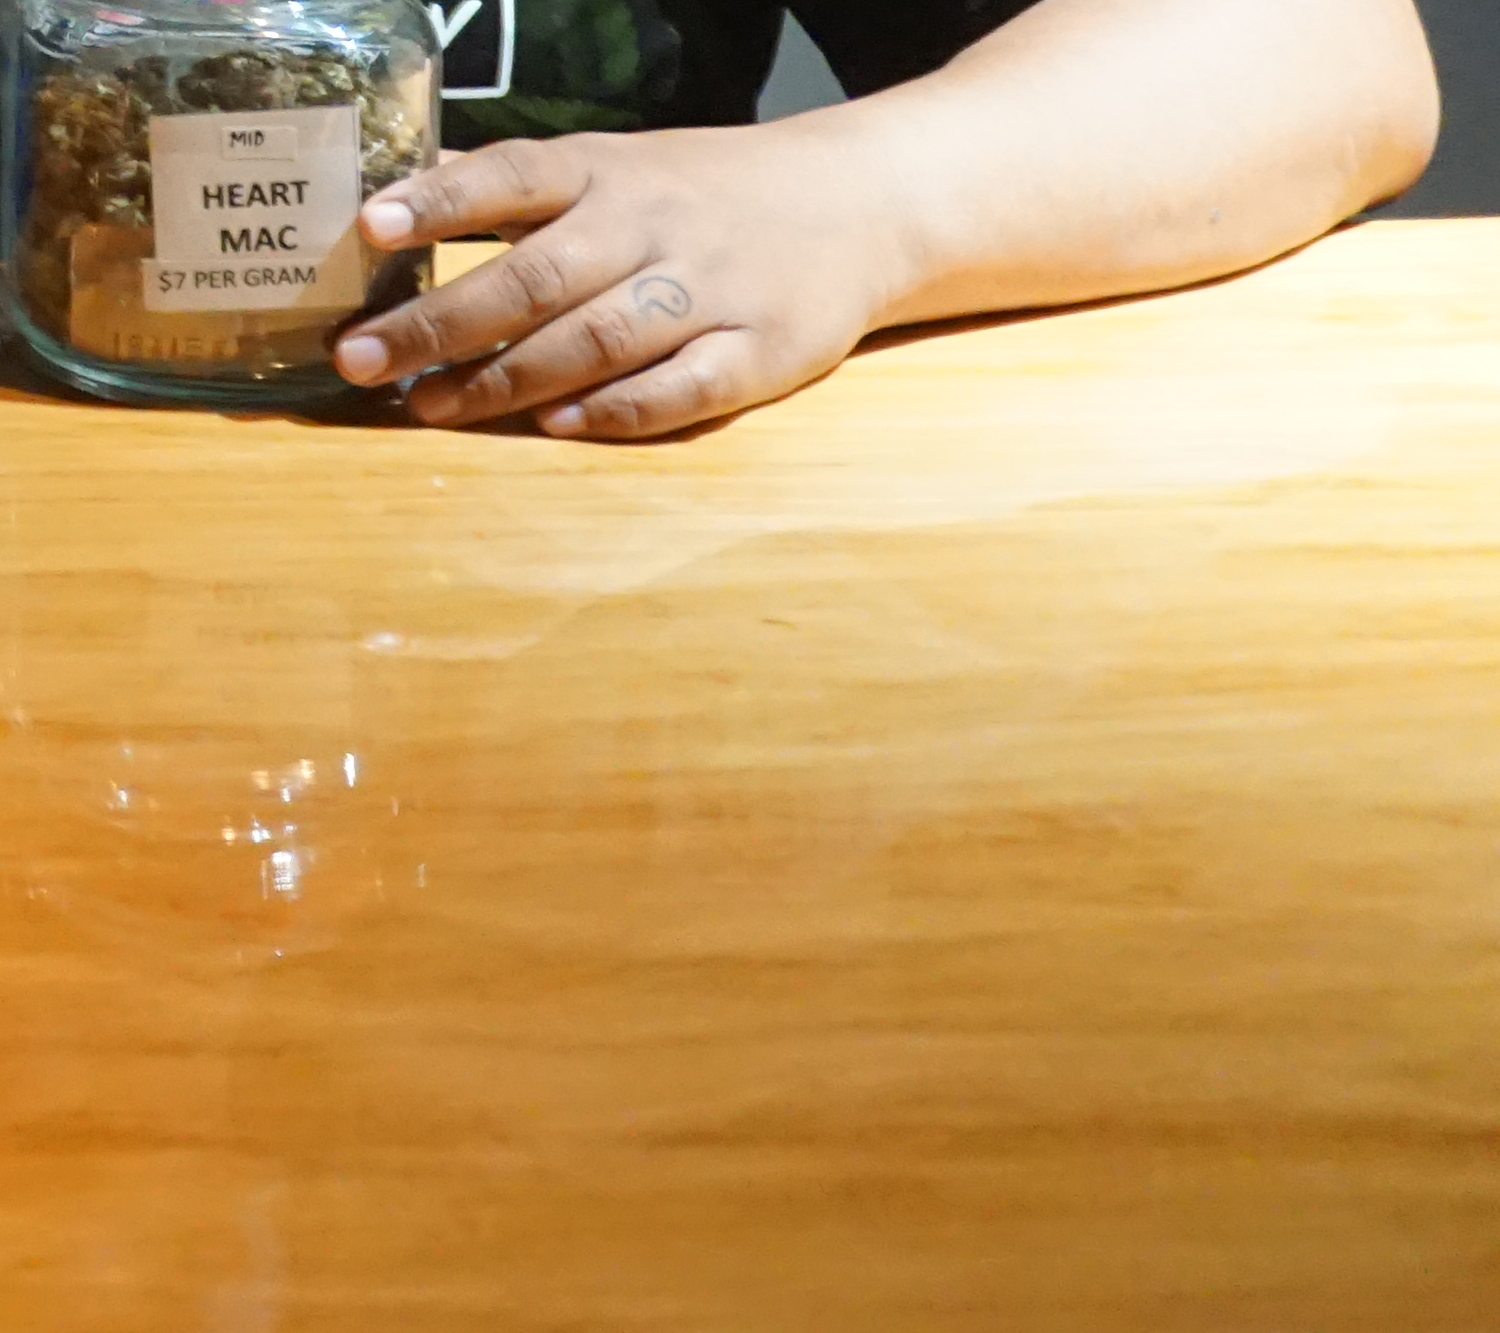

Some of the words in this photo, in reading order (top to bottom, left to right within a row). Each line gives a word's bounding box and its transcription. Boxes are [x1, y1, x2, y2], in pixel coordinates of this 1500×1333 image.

[228, 129, 266, 149] MID
[202, 180, 310, 210] HEART
[218, 225, 299, 254] MAC
[157, 269, 187, 295] $7
[193, 269, 238, 289] PER
[242, 265, 318, 289] GRAM
